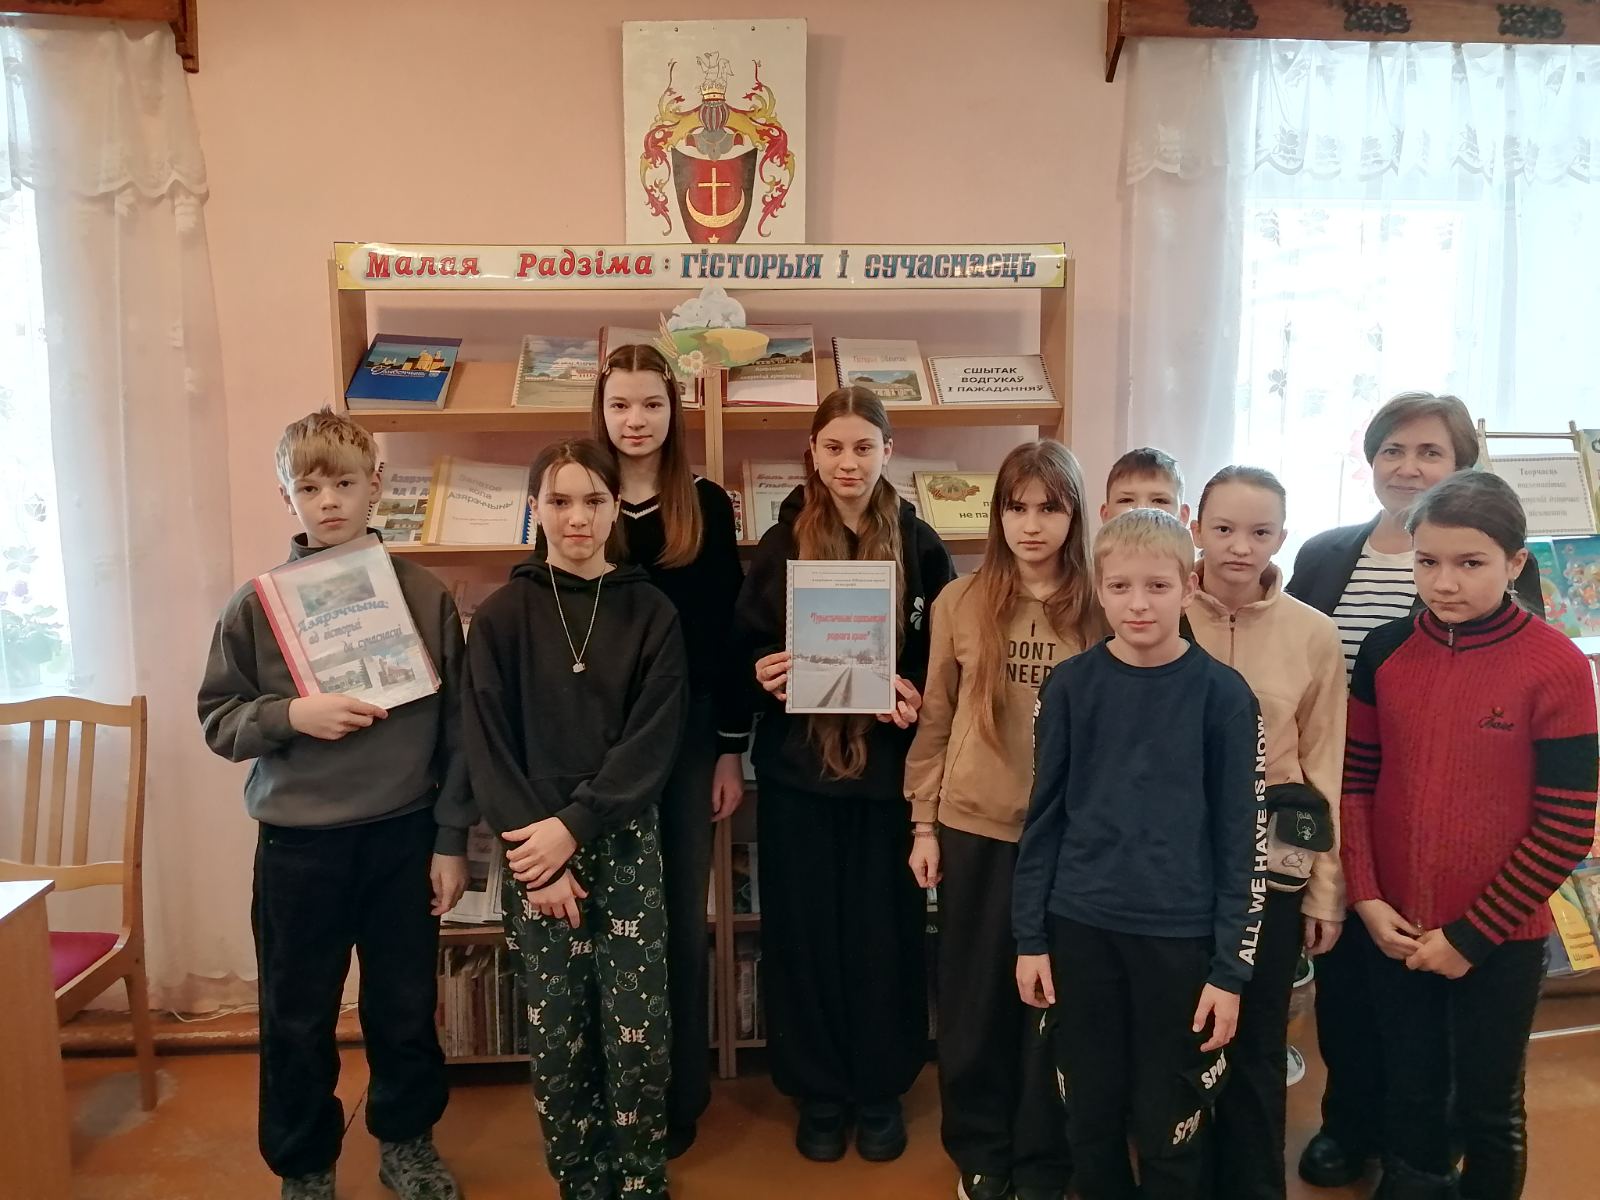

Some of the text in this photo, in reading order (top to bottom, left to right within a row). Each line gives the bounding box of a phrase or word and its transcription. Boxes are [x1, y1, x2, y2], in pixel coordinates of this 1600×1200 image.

[366, 251, 480, 278] Малая
[514, 248, 654, 278] Радзіма
[957, 385, 1044, 393] ПАЖАДАННЯЎ
[961, 376, 1025, 384] ВОДГУКАЎ
[1031, 621, 1036, 638] I
[1007, 640, 1057, 661] DONT
[1238, 715, 1268, 966] ALL WE HAVE IS NOW
